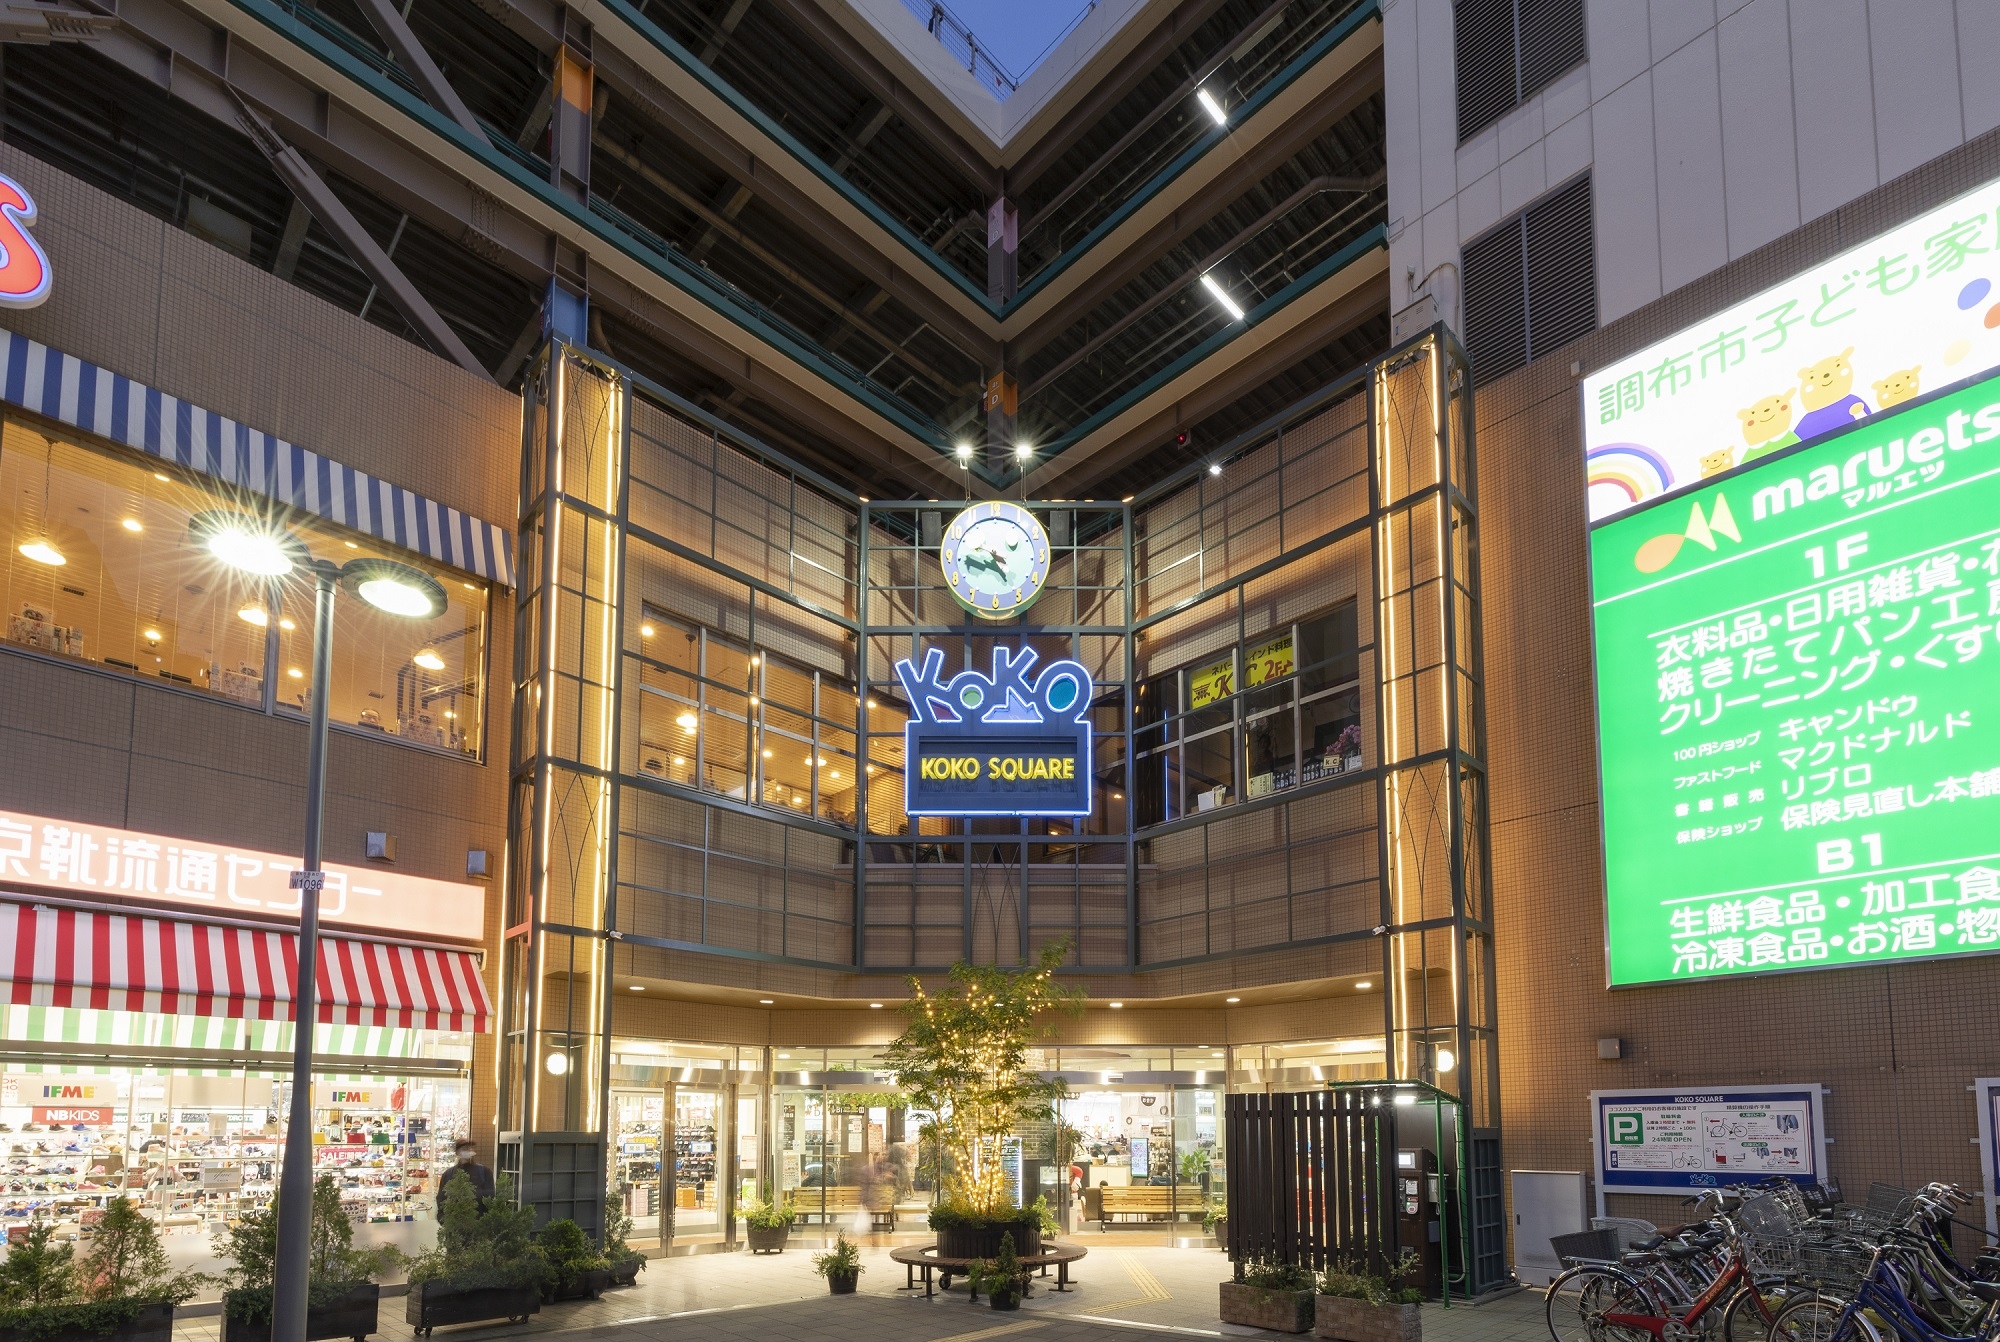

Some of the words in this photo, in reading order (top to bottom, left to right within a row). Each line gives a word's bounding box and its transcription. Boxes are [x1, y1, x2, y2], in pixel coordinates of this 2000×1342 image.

[1598, 203, 2000, 426] 調布市子ども家
[1841, 458, 1945, 509] マルエツ
[1804, 531, 1869, 579] 1F
[1660, 619, 2000, 736] クリーニング・くす
[1778, 710, 1972, 771] マクドナルド
[921, 757, 981, 780] KOKO
[988, 757, 1075, 781] SQUARE
[1781, 763, 1872, 800] リブロ
[1816, 832, 1884, 875] B1
[291, 878, 323, 890] W1096
[43, 1085, 95, 1098] IFME
[332, 1091, 371, 1102] IFME
[1613, 1116, 1639, 1142] P
